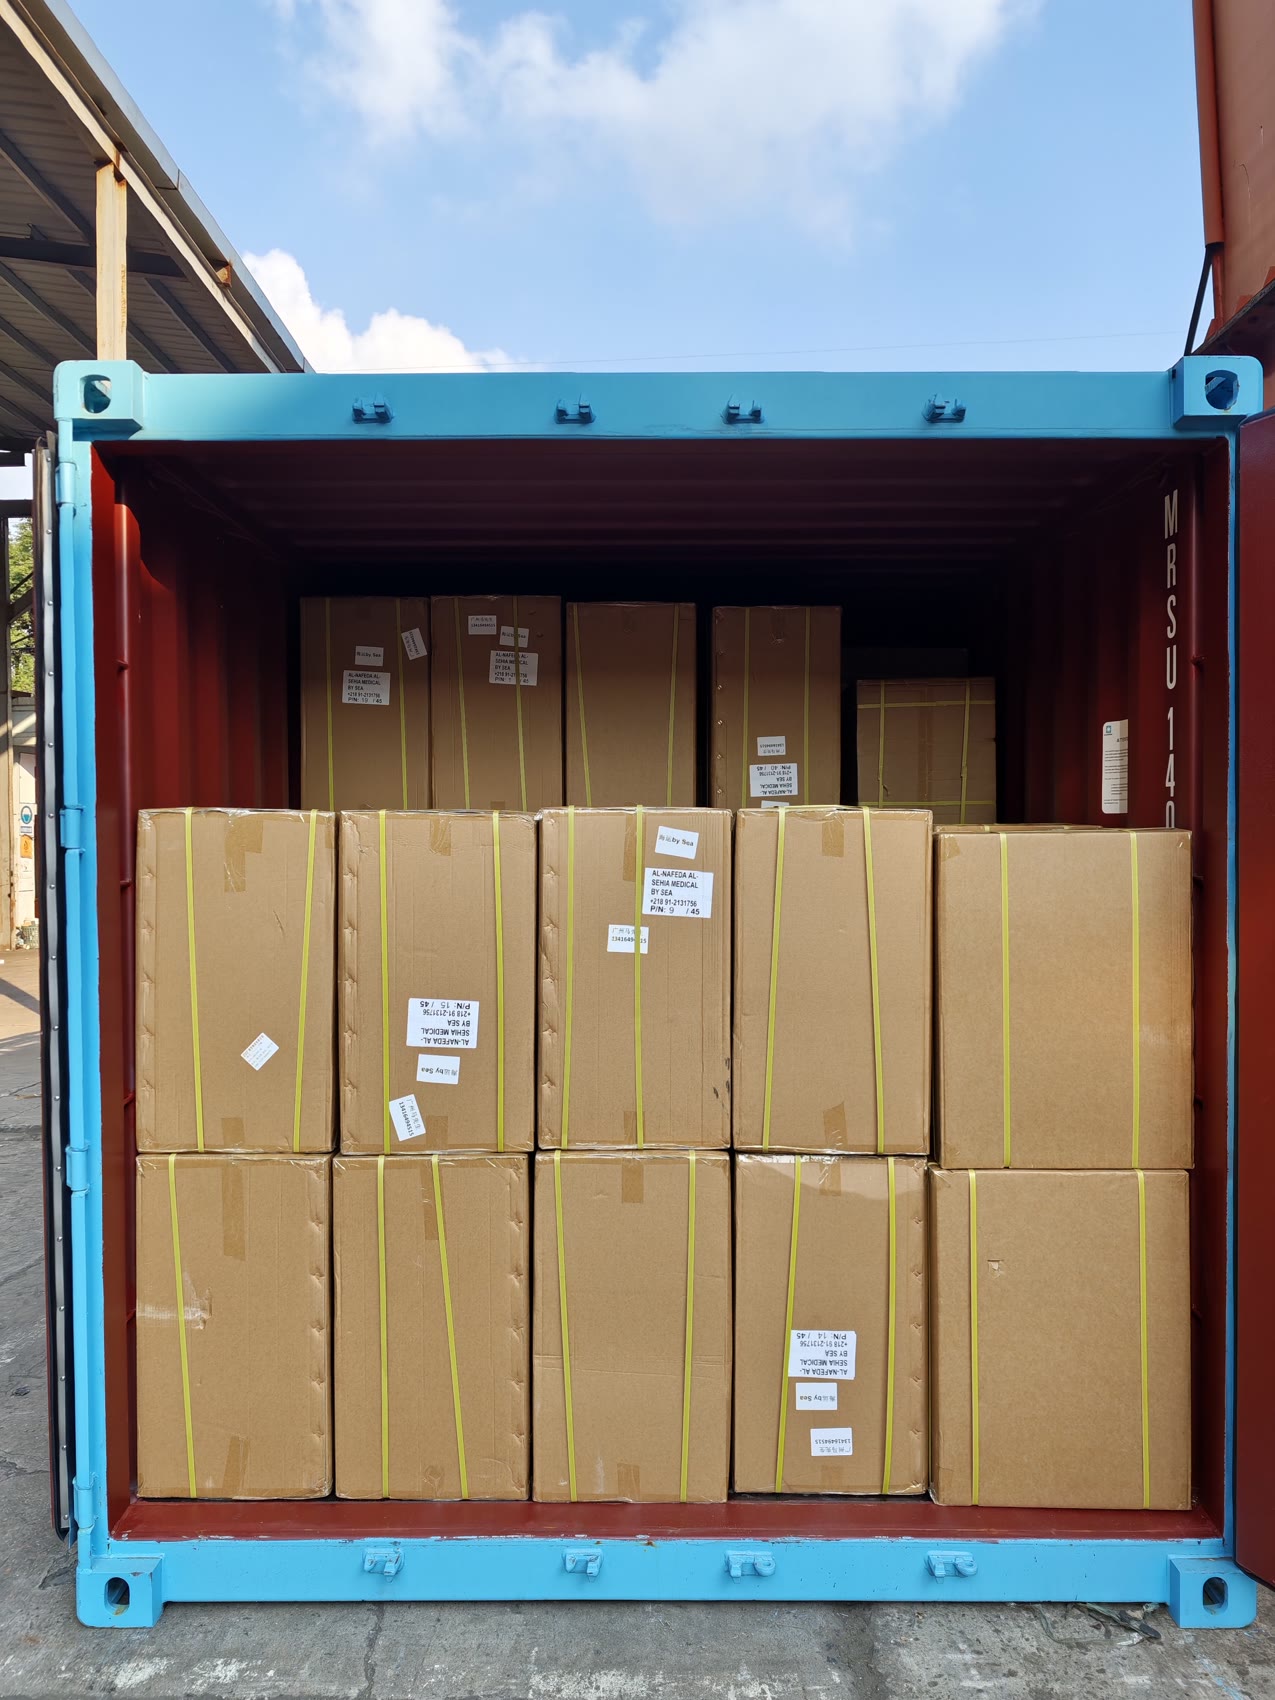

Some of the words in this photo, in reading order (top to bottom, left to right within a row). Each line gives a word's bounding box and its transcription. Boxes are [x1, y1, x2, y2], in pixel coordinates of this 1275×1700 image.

[1164, 489, 1178, 690] MRSU
[652, 870, 687, 878] AL-NAFEDA
[652, 879, 670, 887] SEHIA
[671, 880, 698, 888] MEDICAL
[665, 899, 697, 907] 91-2131756
[454, 1002, 470, 1010] P/N:
[423, 1009, 455, 1017] 91-2131756
[433, 1038, 469, 1046] AL-NAFEDA
